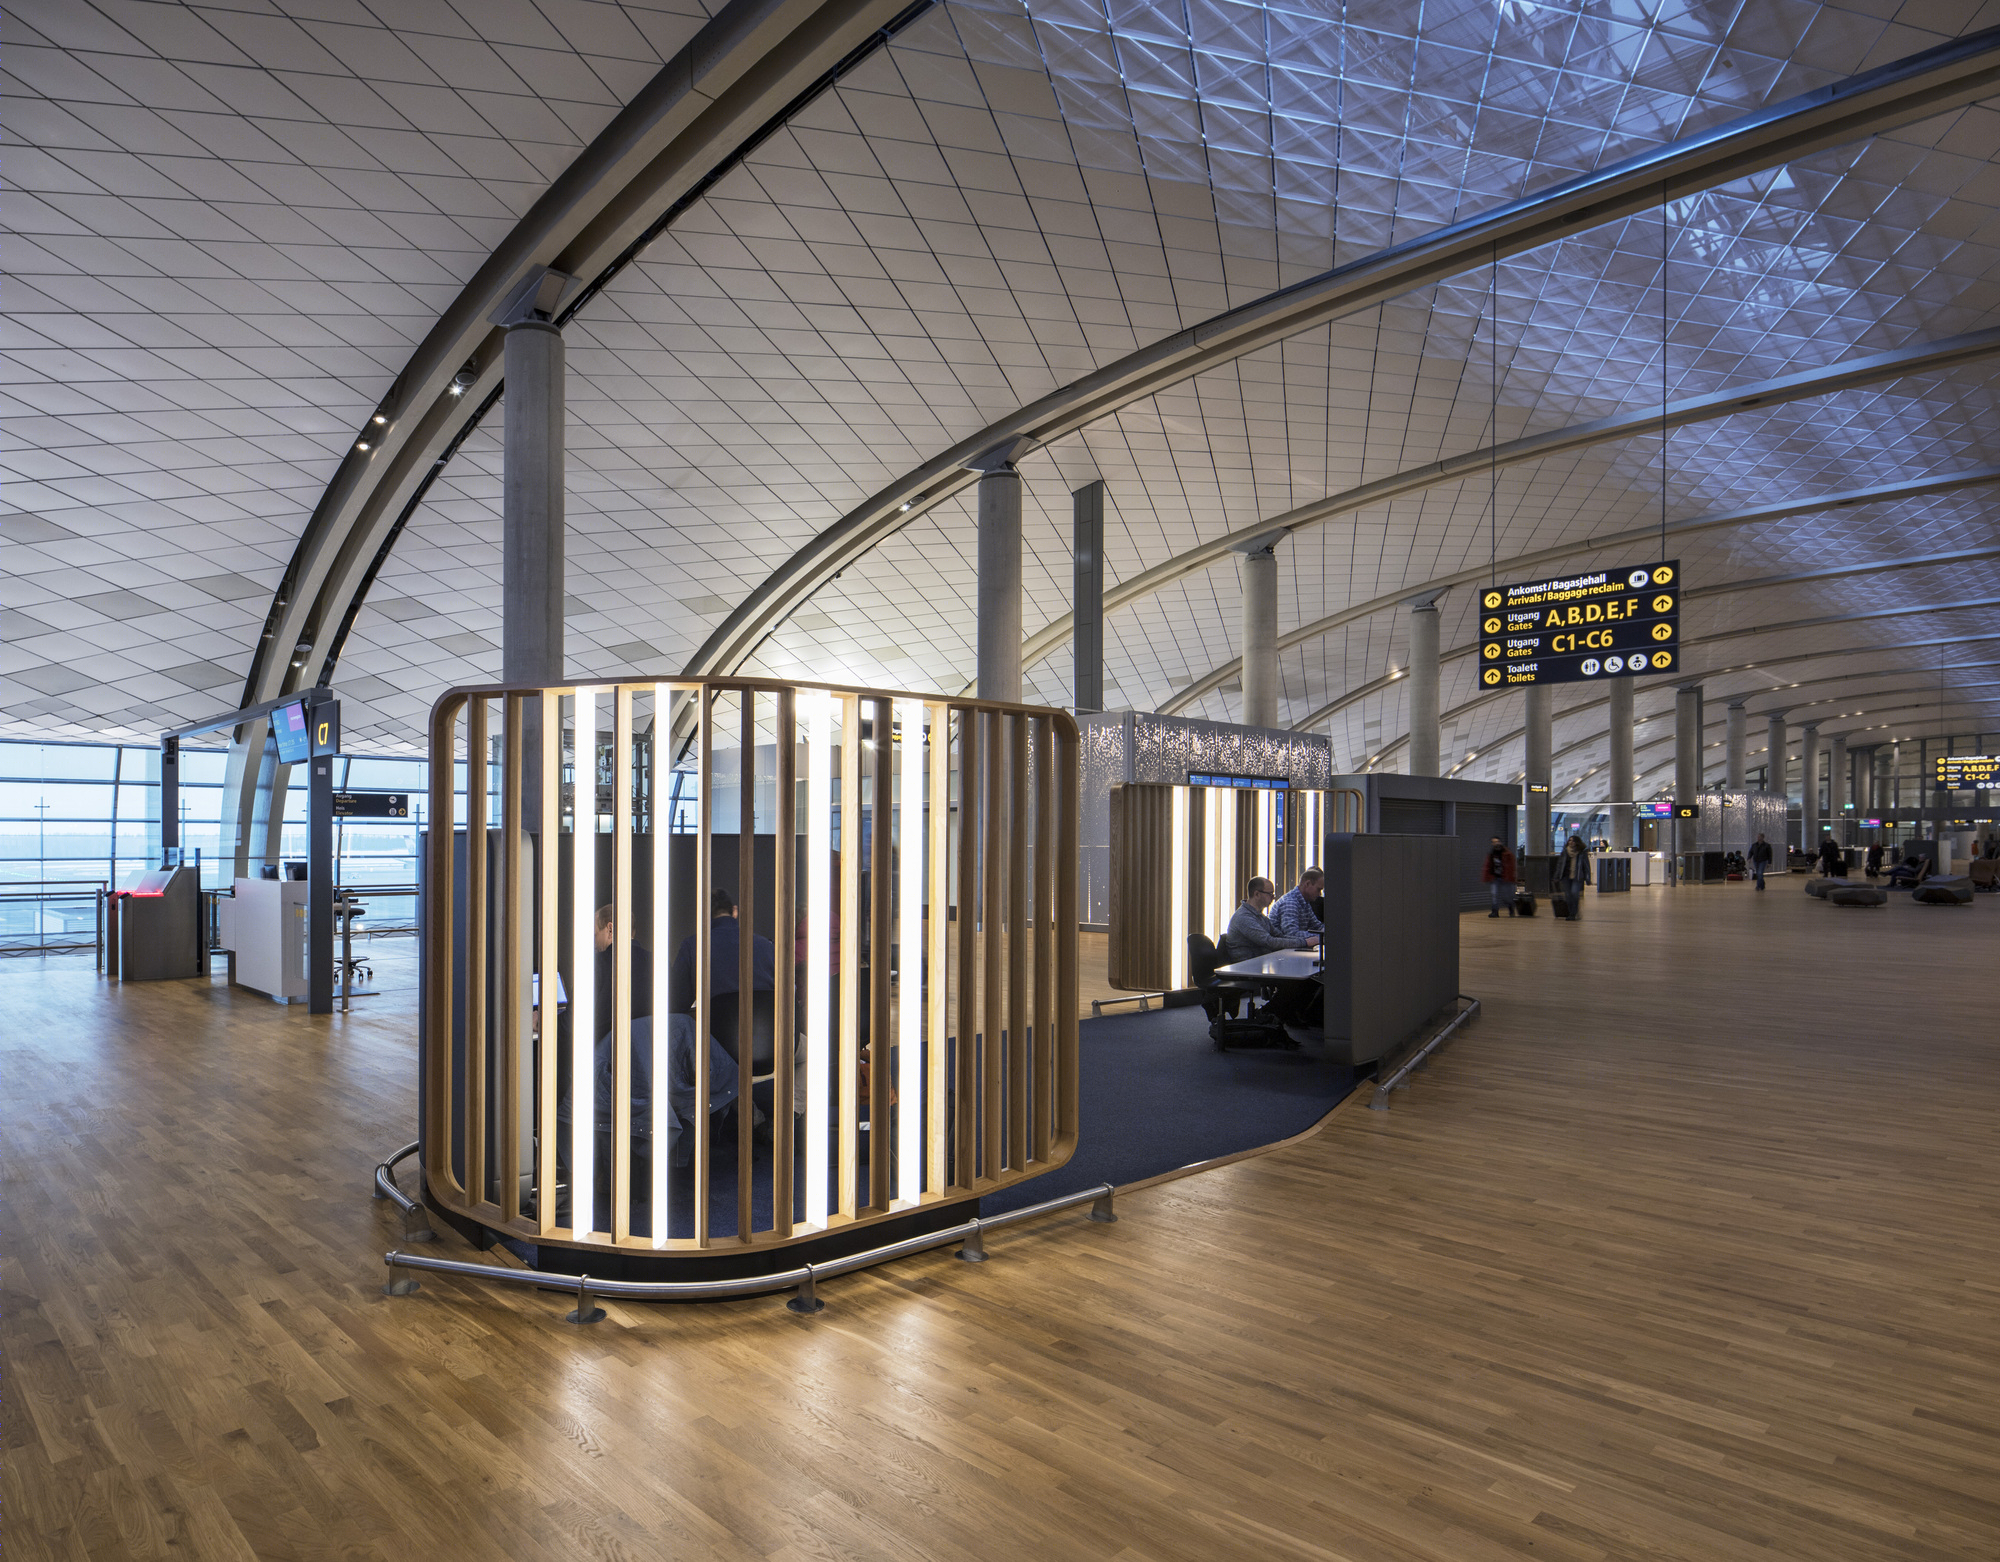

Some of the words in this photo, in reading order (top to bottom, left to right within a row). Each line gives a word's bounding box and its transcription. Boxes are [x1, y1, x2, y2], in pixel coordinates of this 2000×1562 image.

[1507, 582, 1547, 597] Ankomst
[1552, 573, 1606, 591] Bagasjehall
[1507, 593, 1542, 606] Arrivals
[1547, 587, 1588, 601] Baggage
[1589, 582, 1625, 595] reclaim
[1507, 611, 1540, 622] Utgang
[1507, 622, 1533, 632] Gates
[1507, 637, 1540, 649] Utgang
[1552, 629, 1613, 652] C1-C6
[1507, 648, 1533, 658] Gates
[1507, 663, 1538, 674] Toalett
[1507, 673, 1535, 683] Toilets
[318, 722, 329, 746] C7
[1680, 809, 1692, 817] C5
